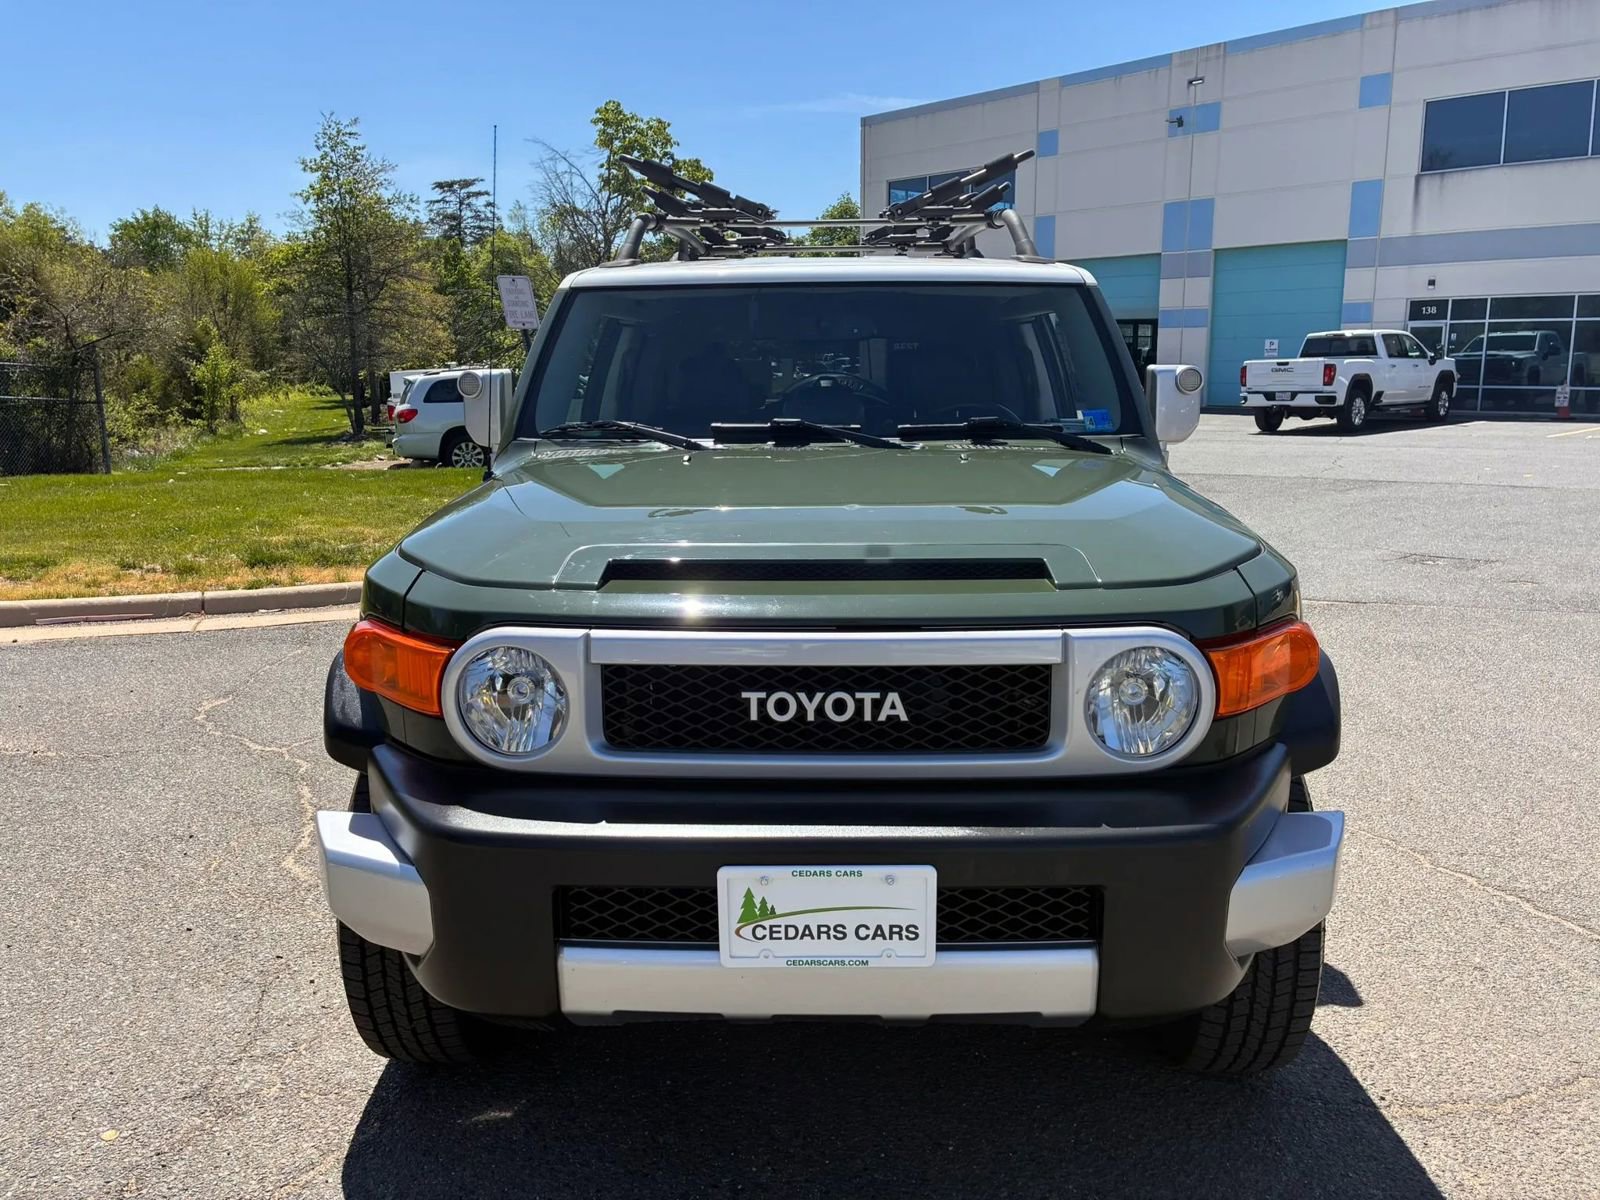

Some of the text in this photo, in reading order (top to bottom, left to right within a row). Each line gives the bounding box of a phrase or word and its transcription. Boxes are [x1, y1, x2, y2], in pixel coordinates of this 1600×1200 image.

[1421, 306, 1437, 315] 138
[741, 691, 909, 722] TOYOTA
[791, 870, 863, 878] CEDARS CARS
[751, 924, 920, 941] CEDARS CARS
[786, 959, 869, 967] CEDARSCARS.COM
